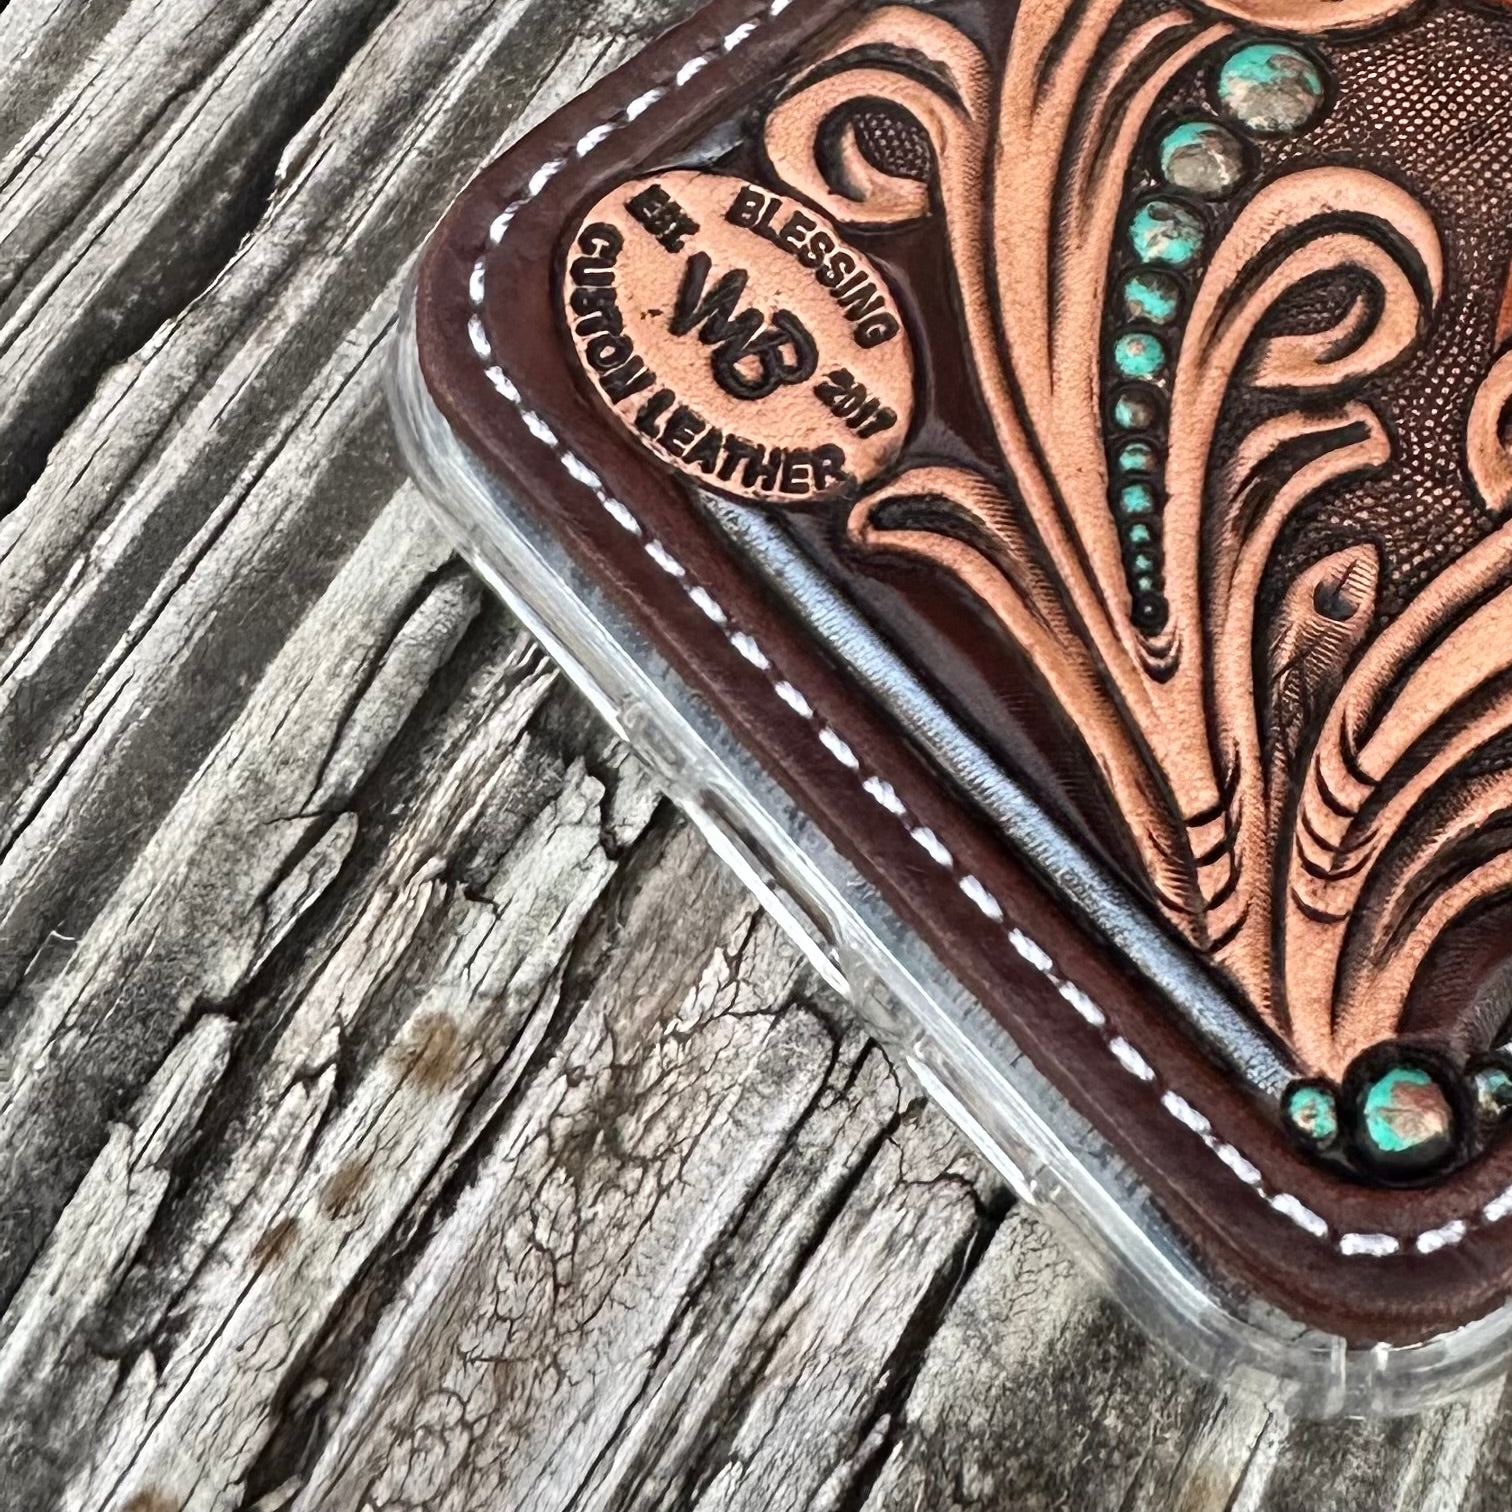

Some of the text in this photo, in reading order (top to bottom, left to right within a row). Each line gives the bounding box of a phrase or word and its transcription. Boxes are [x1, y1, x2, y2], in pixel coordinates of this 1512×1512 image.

[726, 186, 900, 348] BLESSING
[635, 388, 854, 493] LEATHER
[813, 368, 898, 439] 2017
